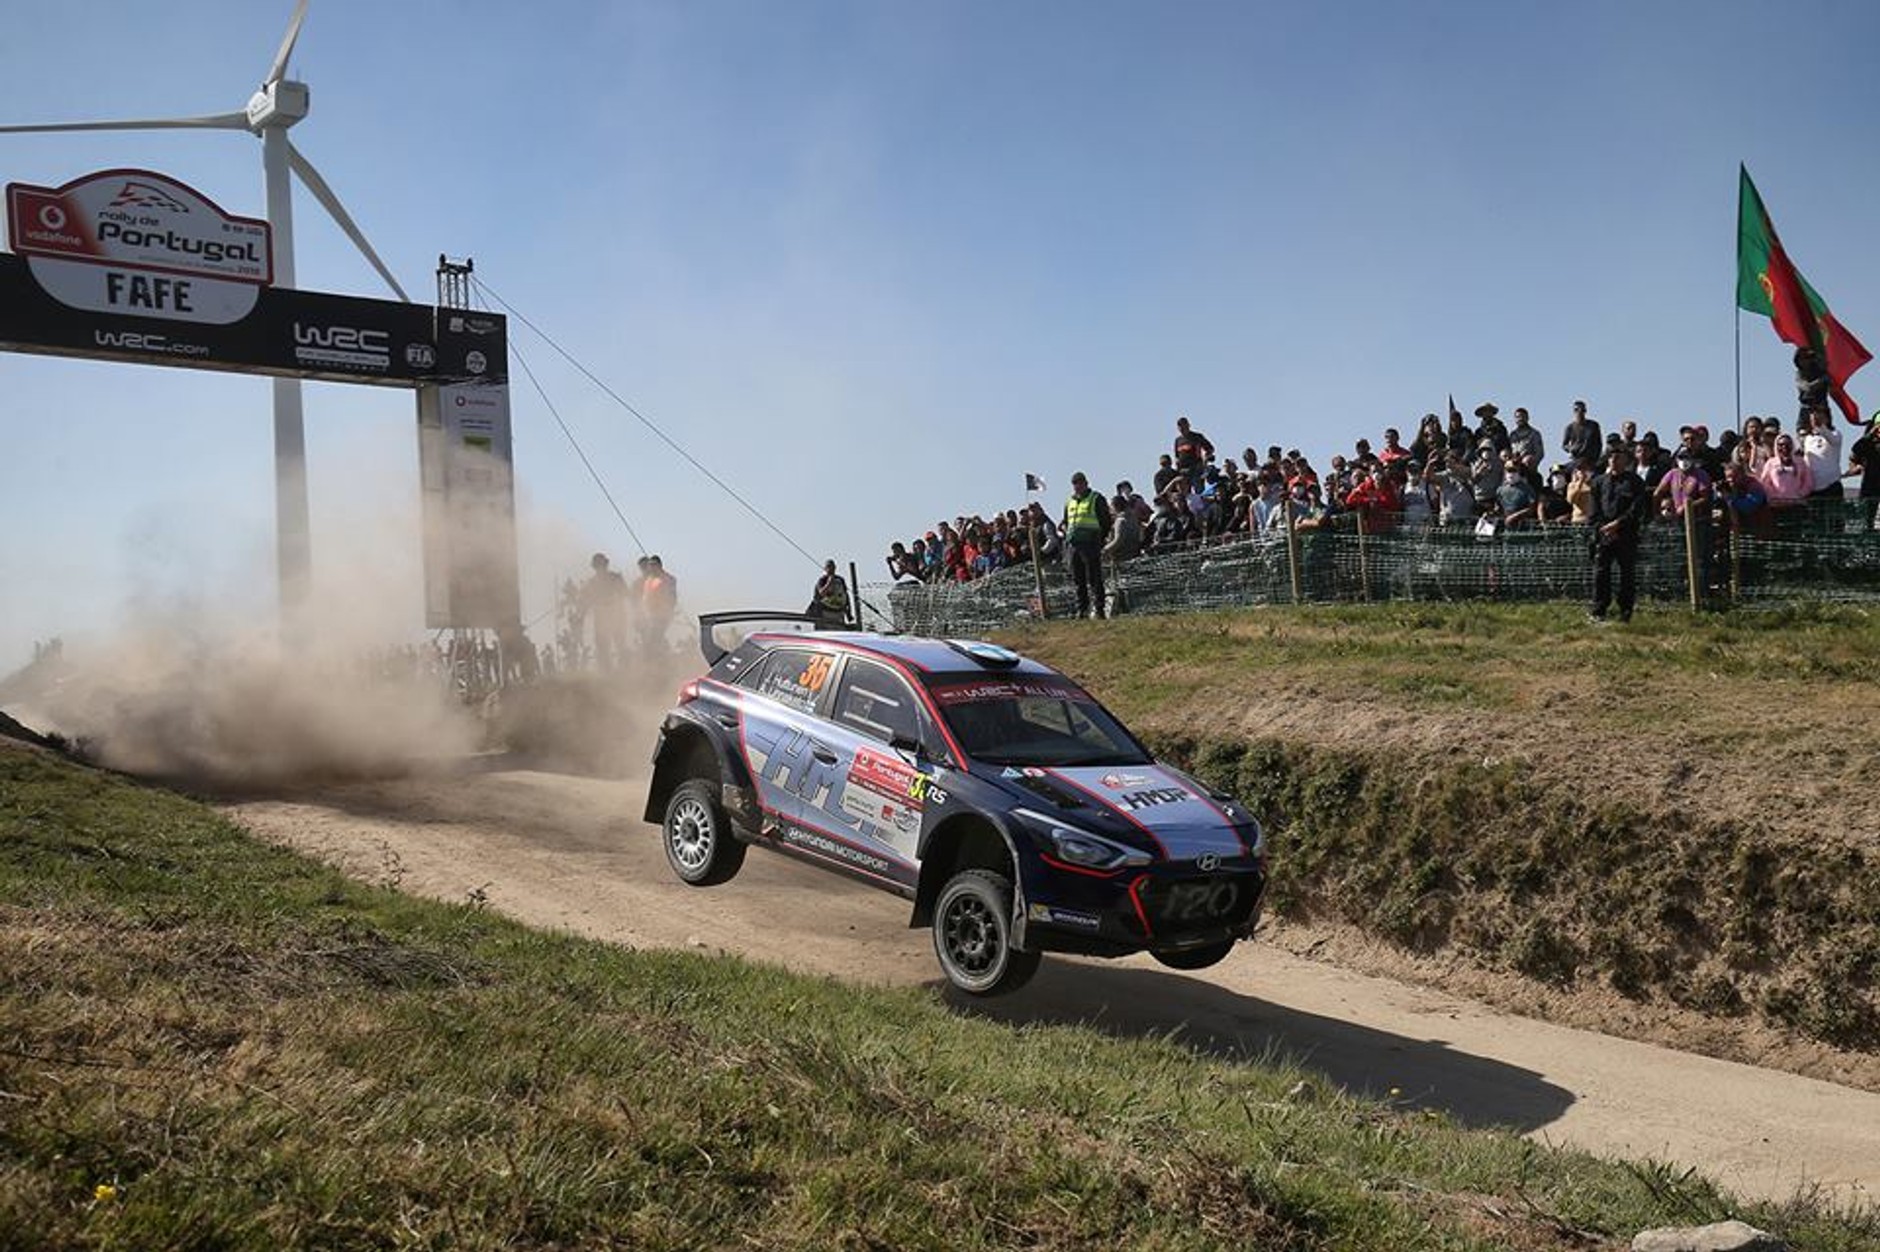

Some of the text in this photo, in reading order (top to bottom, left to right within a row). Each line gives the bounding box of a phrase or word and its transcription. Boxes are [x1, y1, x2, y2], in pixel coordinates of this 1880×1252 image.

[98, 211, 160, 227] rally de
[98, 221, 260, 263] Portugal
[106, 272, 194, 313] FAFE
[294, 322, 390, 352] WRC
[406, 348, 433, 363] FIA
